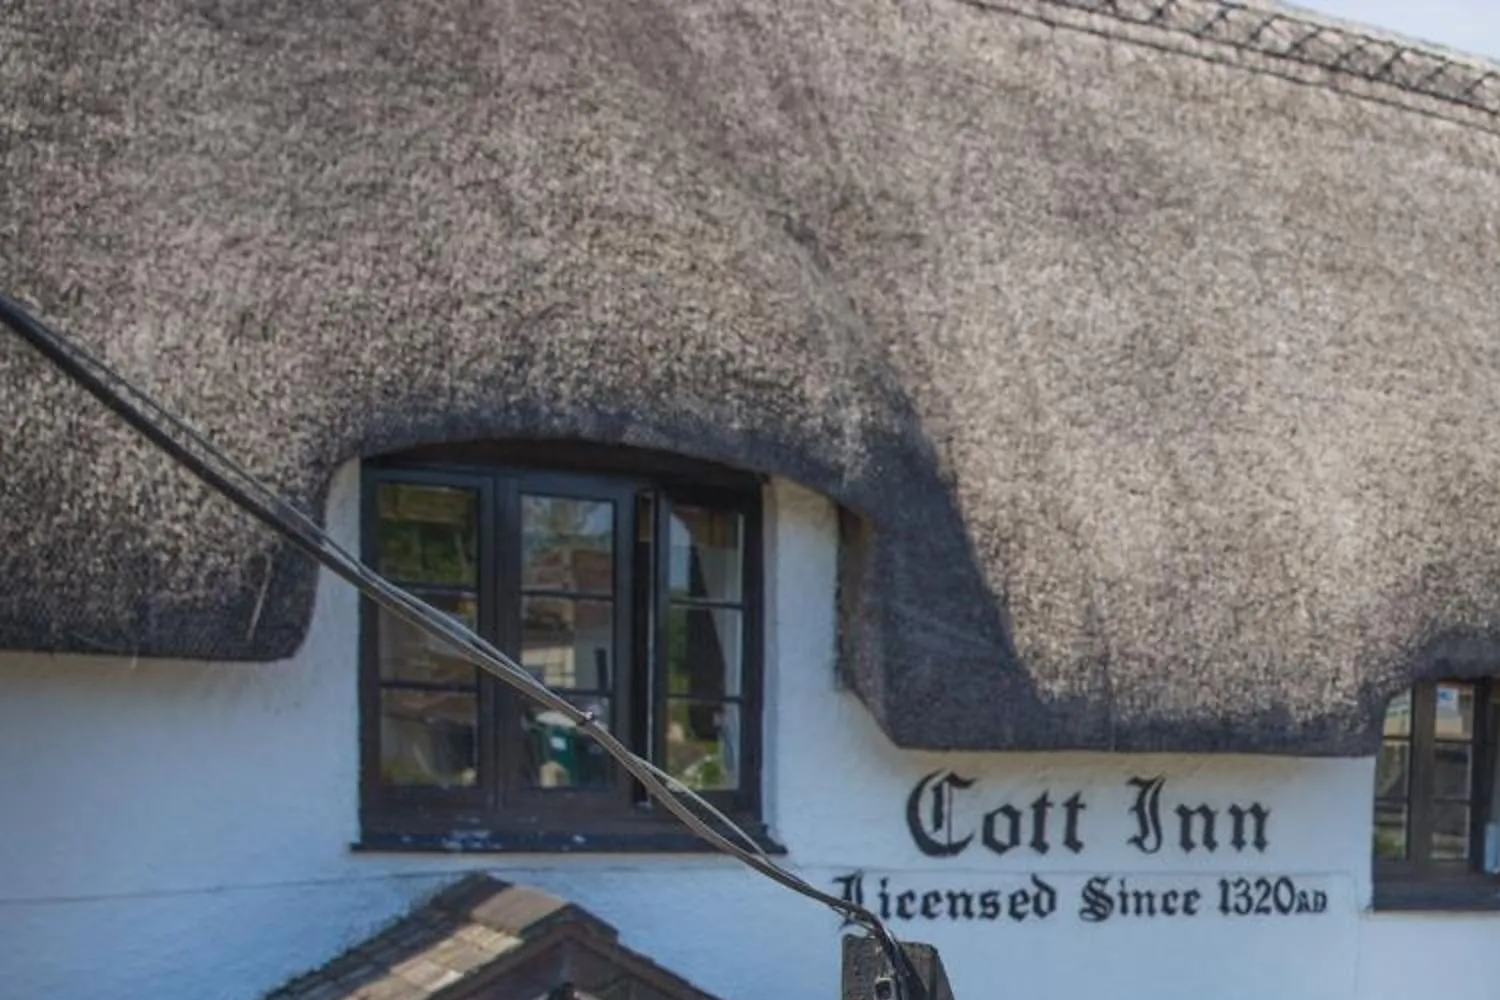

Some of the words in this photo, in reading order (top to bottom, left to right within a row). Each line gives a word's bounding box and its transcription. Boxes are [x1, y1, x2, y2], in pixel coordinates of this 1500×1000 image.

[906, 769, 1086, 857] Cott
[1126, 775, 1270, 854] Inn
[1078, 874, 1201, 924] Since
